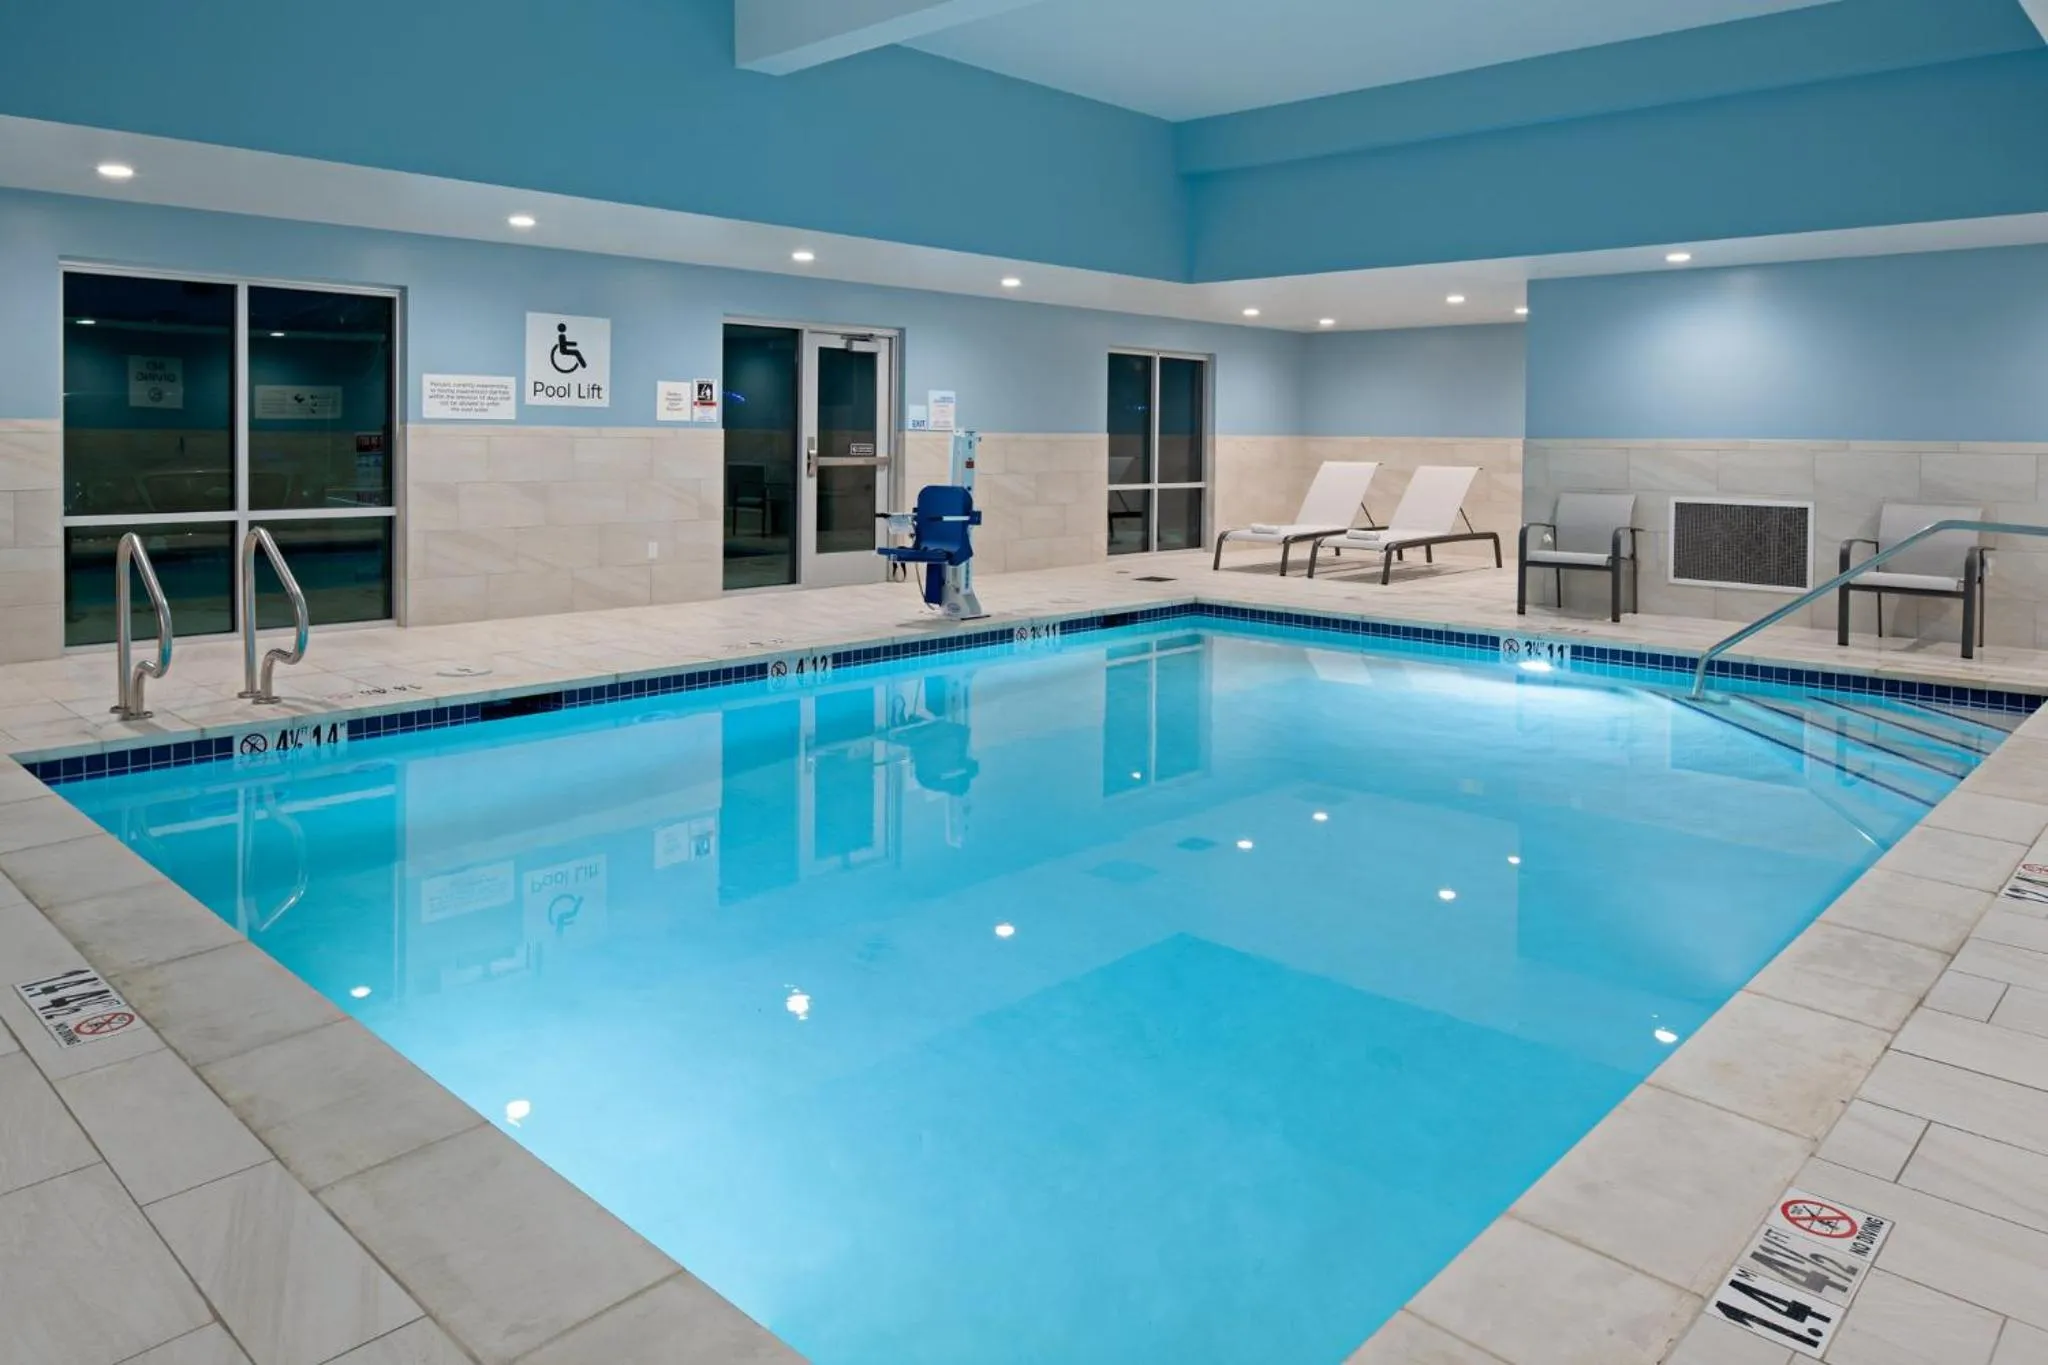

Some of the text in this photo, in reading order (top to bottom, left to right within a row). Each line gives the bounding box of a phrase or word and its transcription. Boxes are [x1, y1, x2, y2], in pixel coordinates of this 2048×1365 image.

[533, 381, 603, 399] Pool Lift
[1849, 1216, 1885, 1257] NO DIVING
[1715, 1279, 1832, 1349] 1.4
